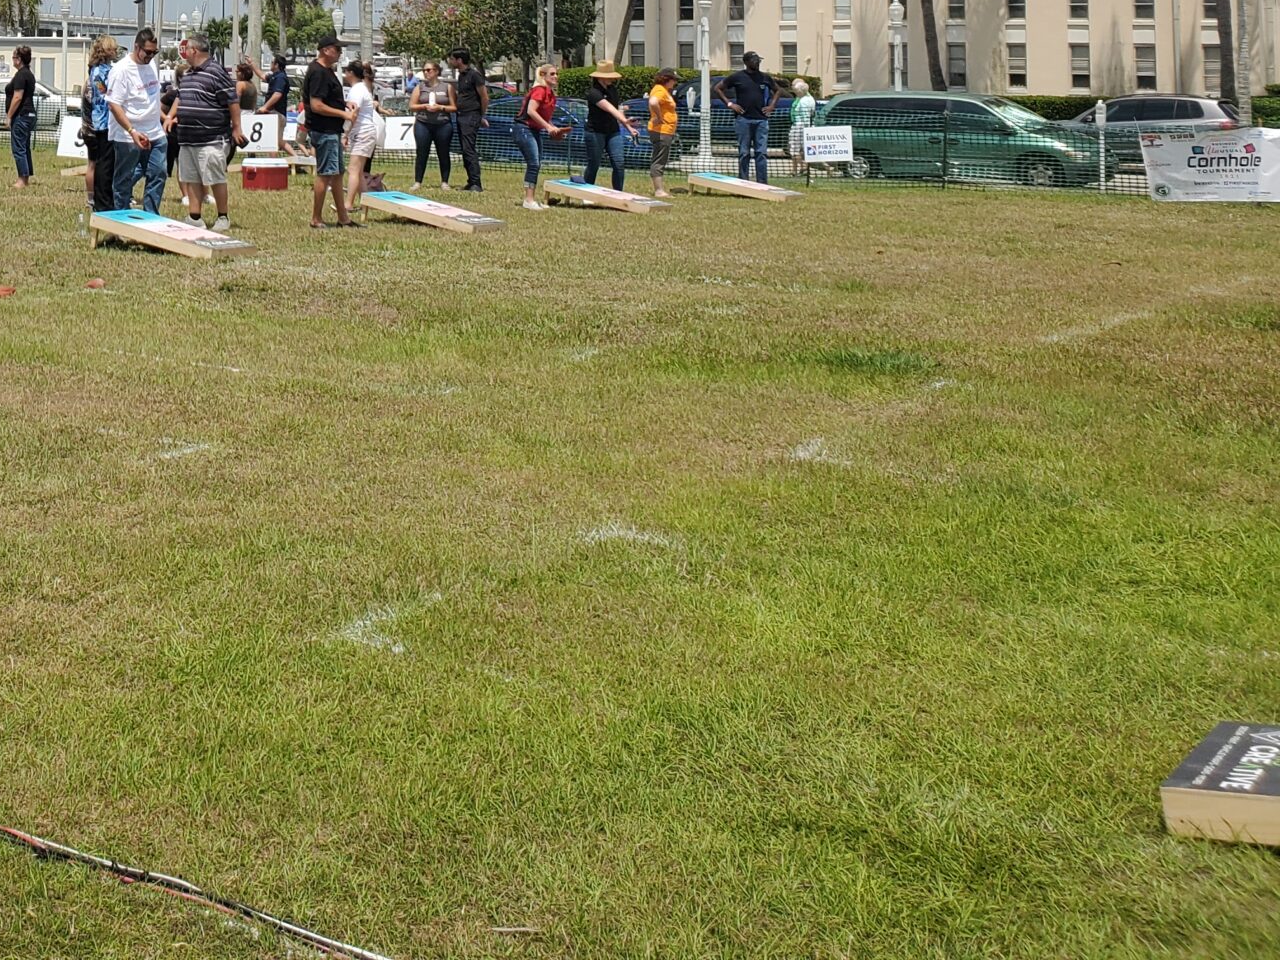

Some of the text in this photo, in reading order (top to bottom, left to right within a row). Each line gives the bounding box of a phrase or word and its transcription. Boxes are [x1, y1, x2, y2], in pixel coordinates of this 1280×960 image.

[250, 122, 263, 142] 8
[400, 123, 414, 141] 7
[1187, 153, 1262, 168] Cornhole
[1219, 745, 1280, 791] CREATIVE
